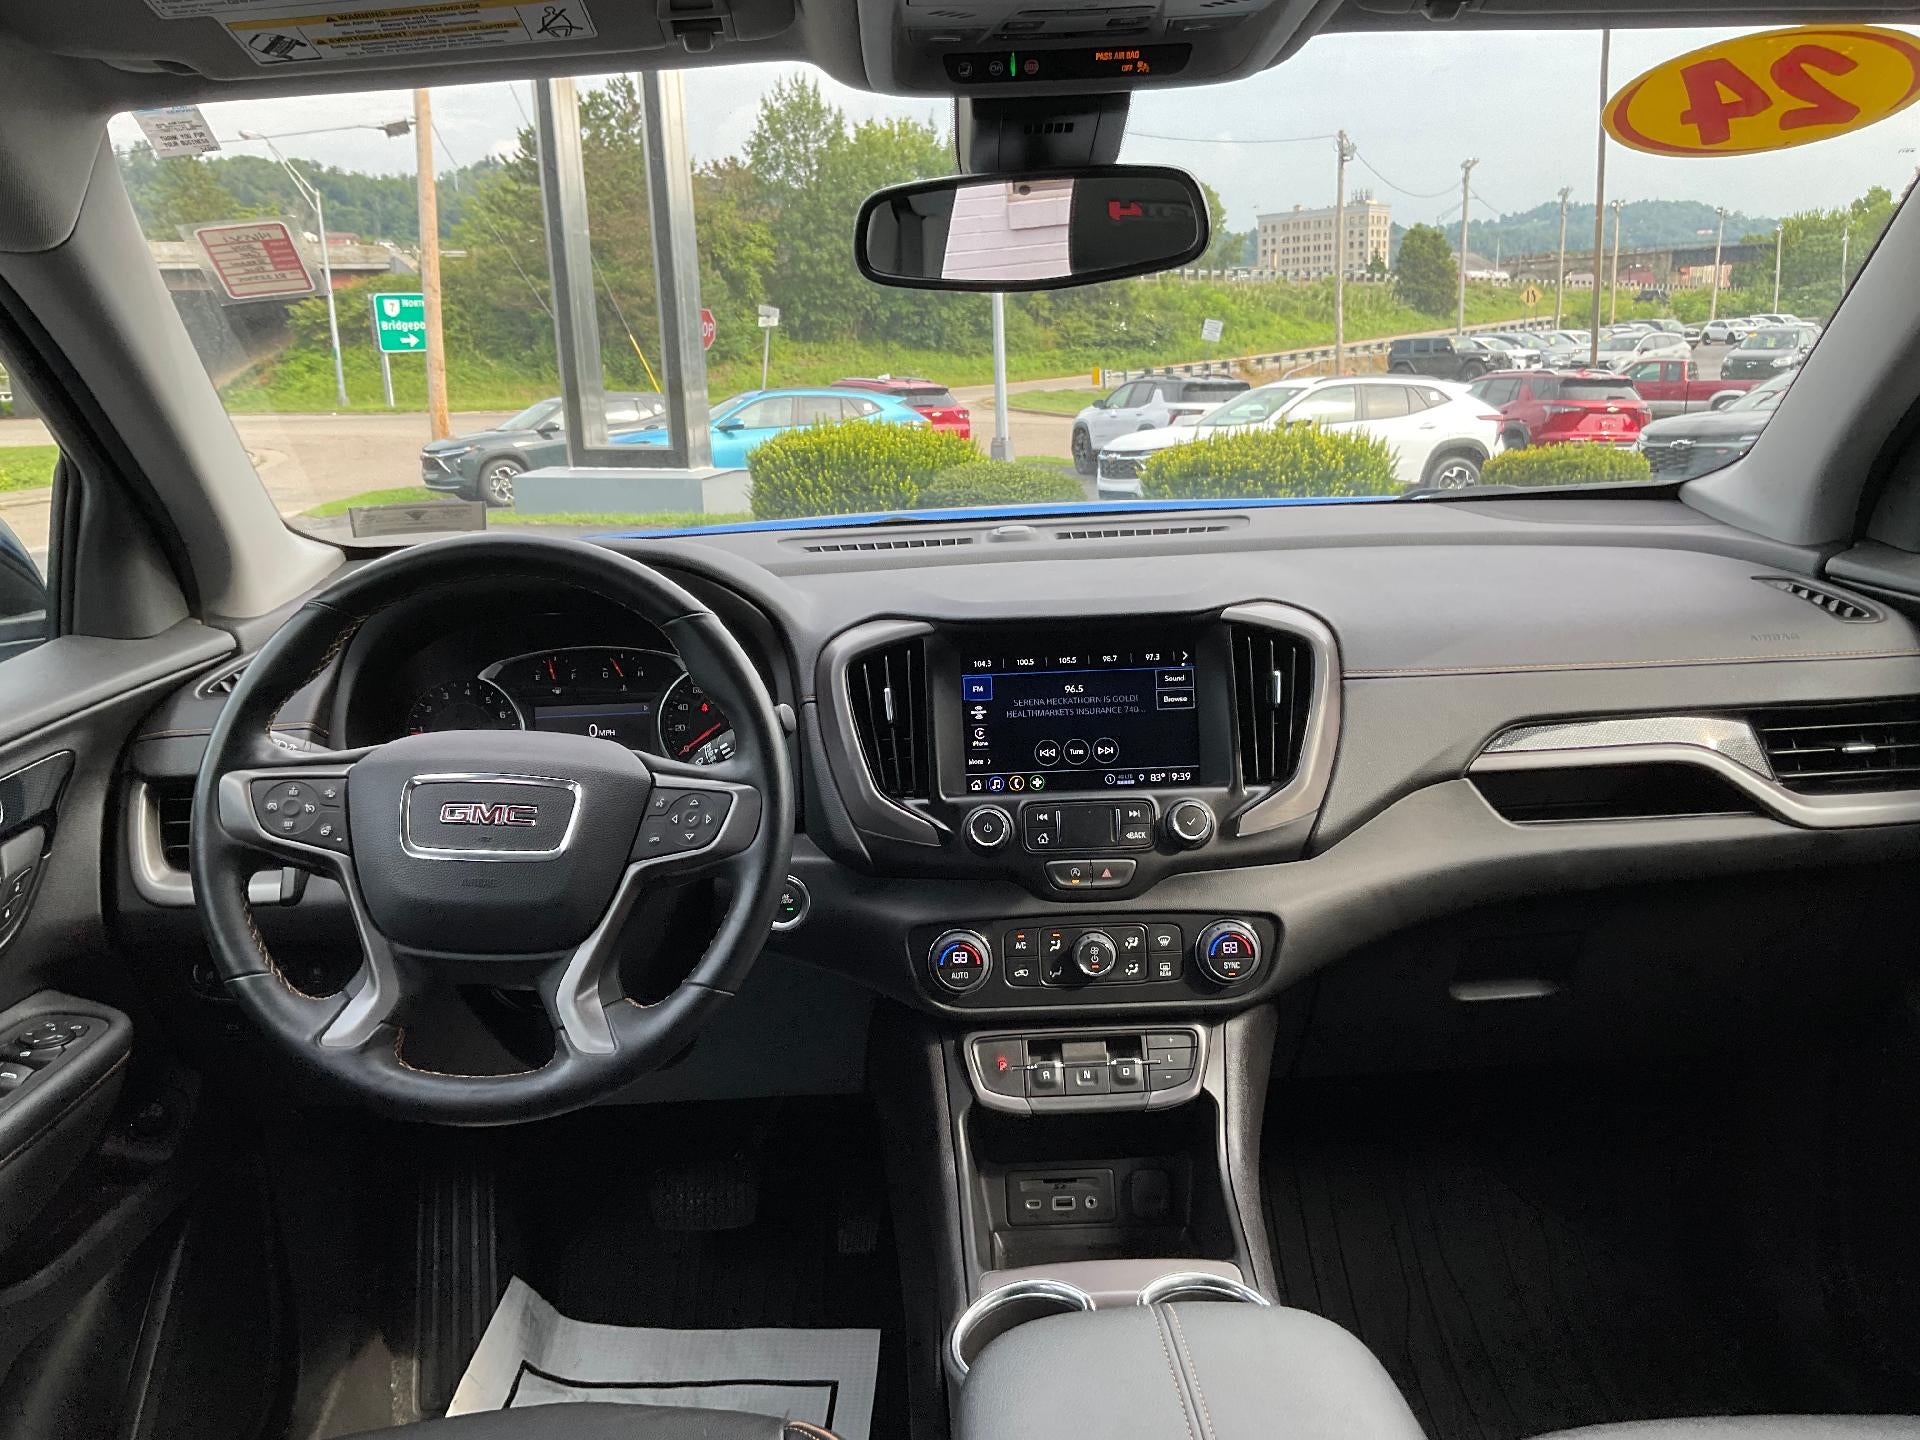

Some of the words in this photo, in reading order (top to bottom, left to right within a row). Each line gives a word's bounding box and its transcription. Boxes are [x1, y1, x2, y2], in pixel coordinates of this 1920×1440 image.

[1096, 53, 1112, 61] PASS
[389, 302, 395, 313] 7
[381, 320, 426, 332] Bridgepo
[973, 660, 992, 668] 104.3
[1016, 658, 1034, 666] 100.5
[1058, 656, 1077, 665] 105.5
[1145, 653, 1160, 661] 97.3
[1164, 674, 1185, 683] Sound
[972, 685, 984, 693] FM
[1064, 684, 1084, 693] 96.5
[442, 692, 449, 700] 3
[485, 696, 491, 704] 5
[1163, 695, 1188, 703] Browse
[1013, 699, 1045, 707] SERENA
[1046, 696, 1101, 706] HECKATHORN
[1103, 695, 1111, 703] IS
[426, 705, 432, 713] 2
[678, 703, 689, 711] 40
[499, 711, 506, 719] 6
[1006, 708, 1074, 718] HEALTHMARKETS
[1076, 706, 1122, 715] INSURANCE
[588, 723, 598, 738] 0
[598, 729, 616, 737] MPH
[674, 724, 686, 732] 20
[1171, 771, 1191, 781] 9:39
[439, 802, 538, 829] GMC
[1129, 831, 1146, 840] BACK
[1014, 941, 1028, 950] A/C
[1223, 941, 1239, 954] 68
[952, 951, 968, 964] 68
[1223, 960, 1241, 971] SYNC
[951, 971, 969, 981] AUTO
[1158, 968, 1173, 977] REAR
[1168, 1054, 1173, 1062] L
[998, 1059, 1008, 1070] P
[1083, 1069, 1091, 1079] N
[1122, 1066, 1130, 1076] D
